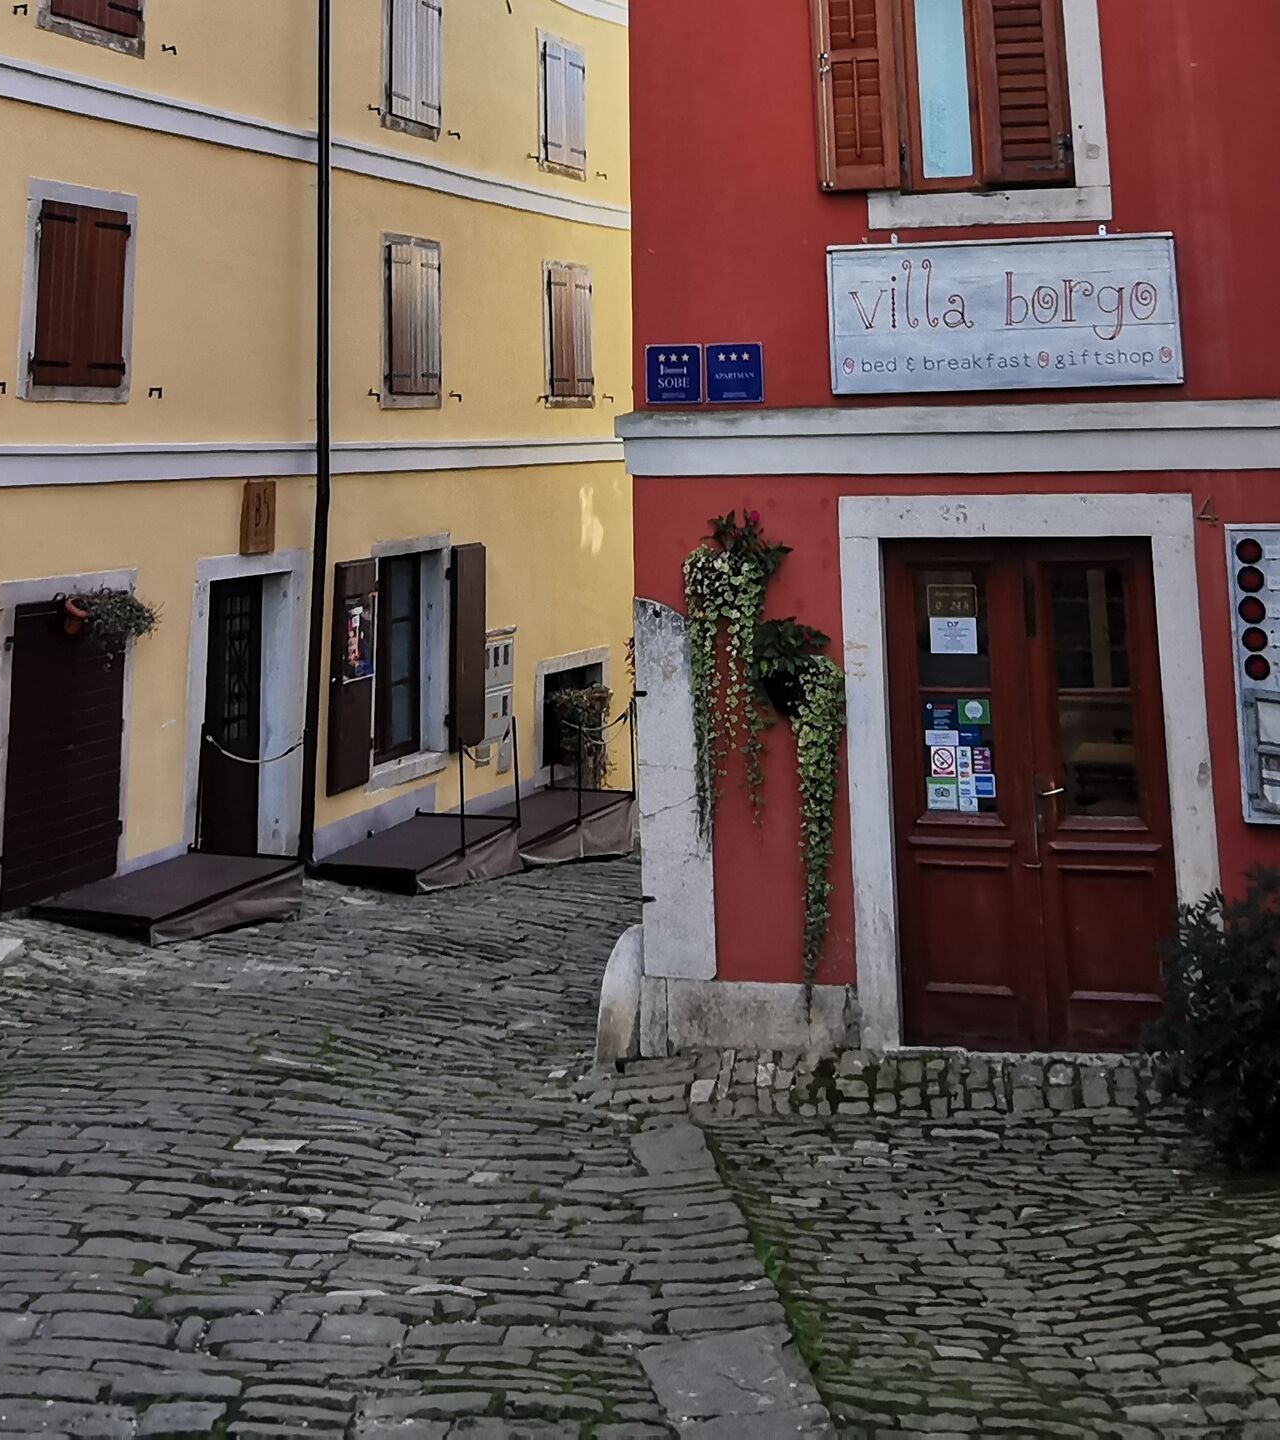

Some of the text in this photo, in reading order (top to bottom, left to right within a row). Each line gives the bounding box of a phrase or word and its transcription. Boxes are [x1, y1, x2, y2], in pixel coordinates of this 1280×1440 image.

[849, 258, 1158, 341] villa borgo
[861, 348, 1154, 373] bed & breakfast giftshop
[657, 377, 690, 389] SOBE
[714, 371, 755, 380] APARTMAN
[1197, 494, 1219, 527] 4
